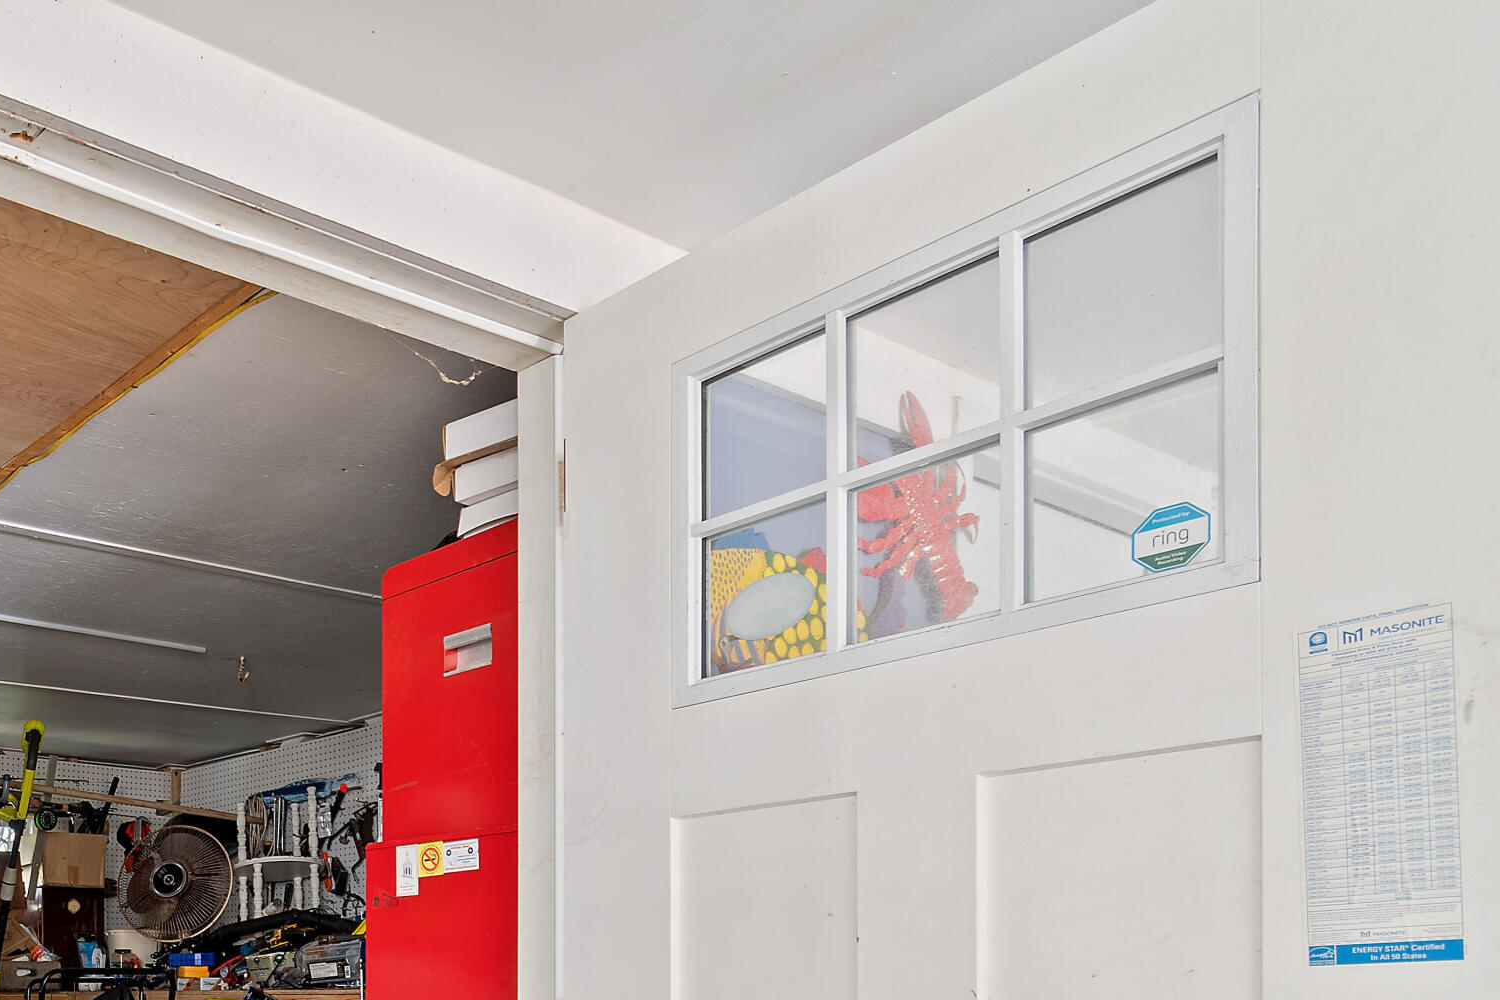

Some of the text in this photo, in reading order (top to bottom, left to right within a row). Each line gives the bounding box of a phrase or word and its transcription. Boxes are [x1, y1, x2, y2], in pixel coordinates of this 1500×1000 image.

[1152, 528, 1189, 547] ring
[1369, 614, 1445, 637] MASONITE
[1352, 945, 1383, 954] ENERGY
[1411, 942, 1446, 951] Certified
[1370, 953, 1379, 961] In
[1391, 952, 1401, 960] 50
[1402, 952, 1427, 960] States
